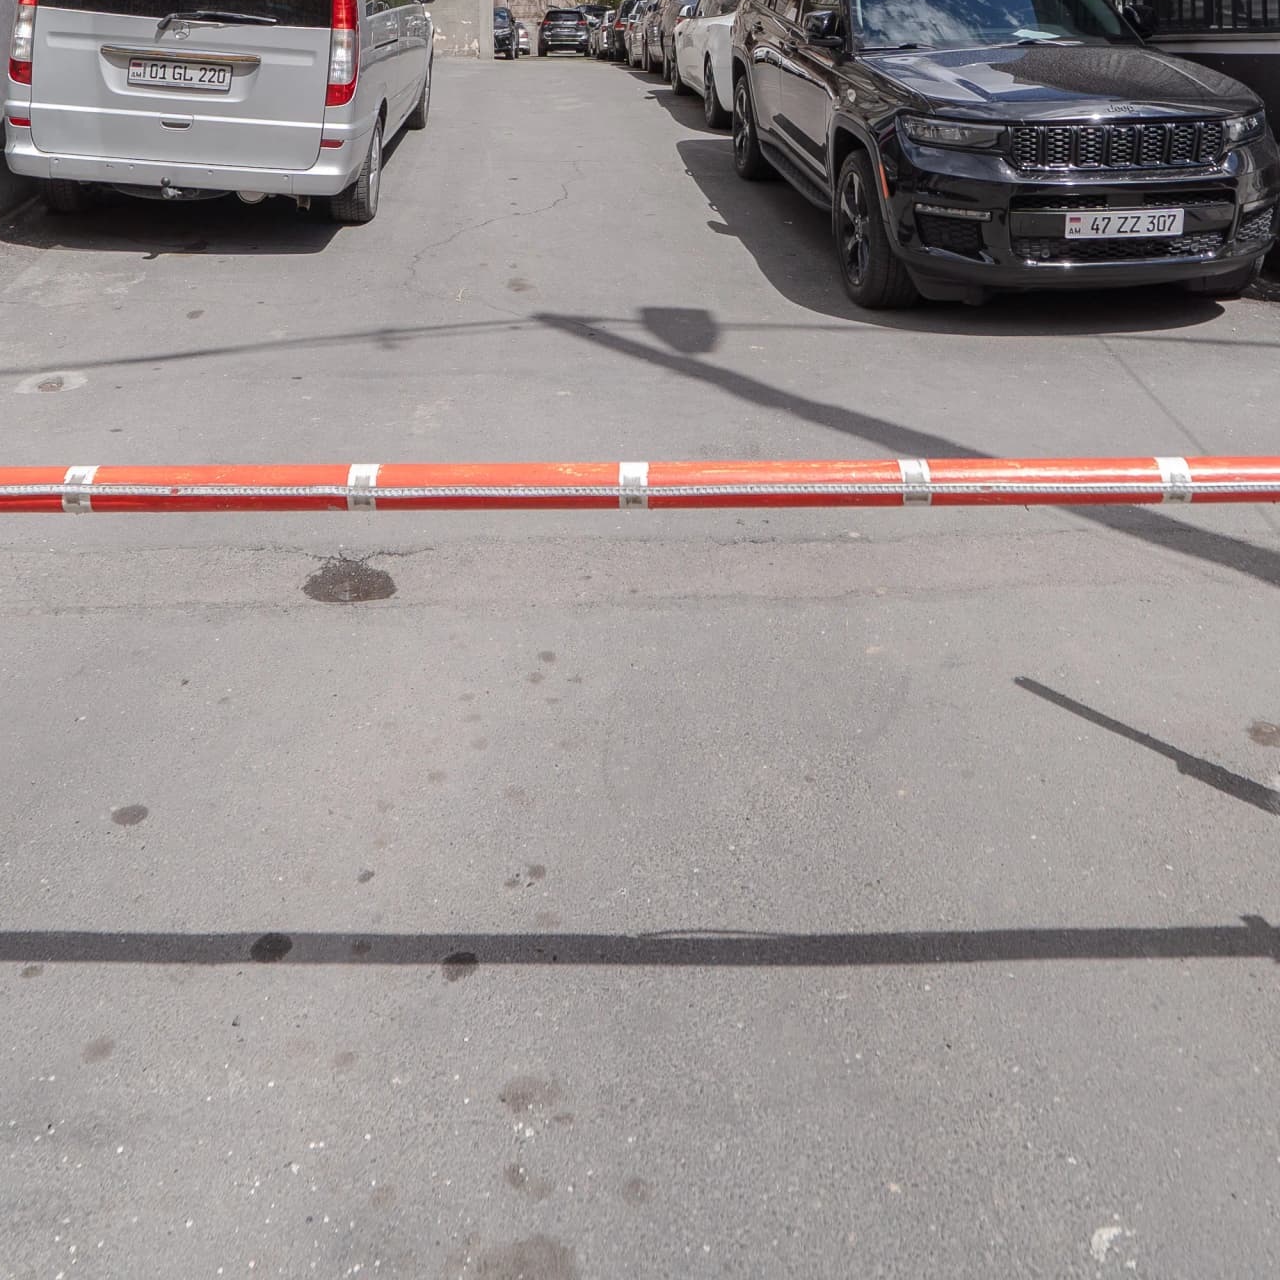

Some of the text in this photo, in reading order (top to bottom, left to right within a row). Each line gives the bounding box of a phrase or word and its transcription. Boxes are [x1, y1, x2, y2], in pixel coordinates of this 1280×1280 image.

[150, 63, 226, 84] 01 GL 220
[1069, 227, 1081, 235] AM
[1091, 213, 1176, 234] 47 ZZ 307
